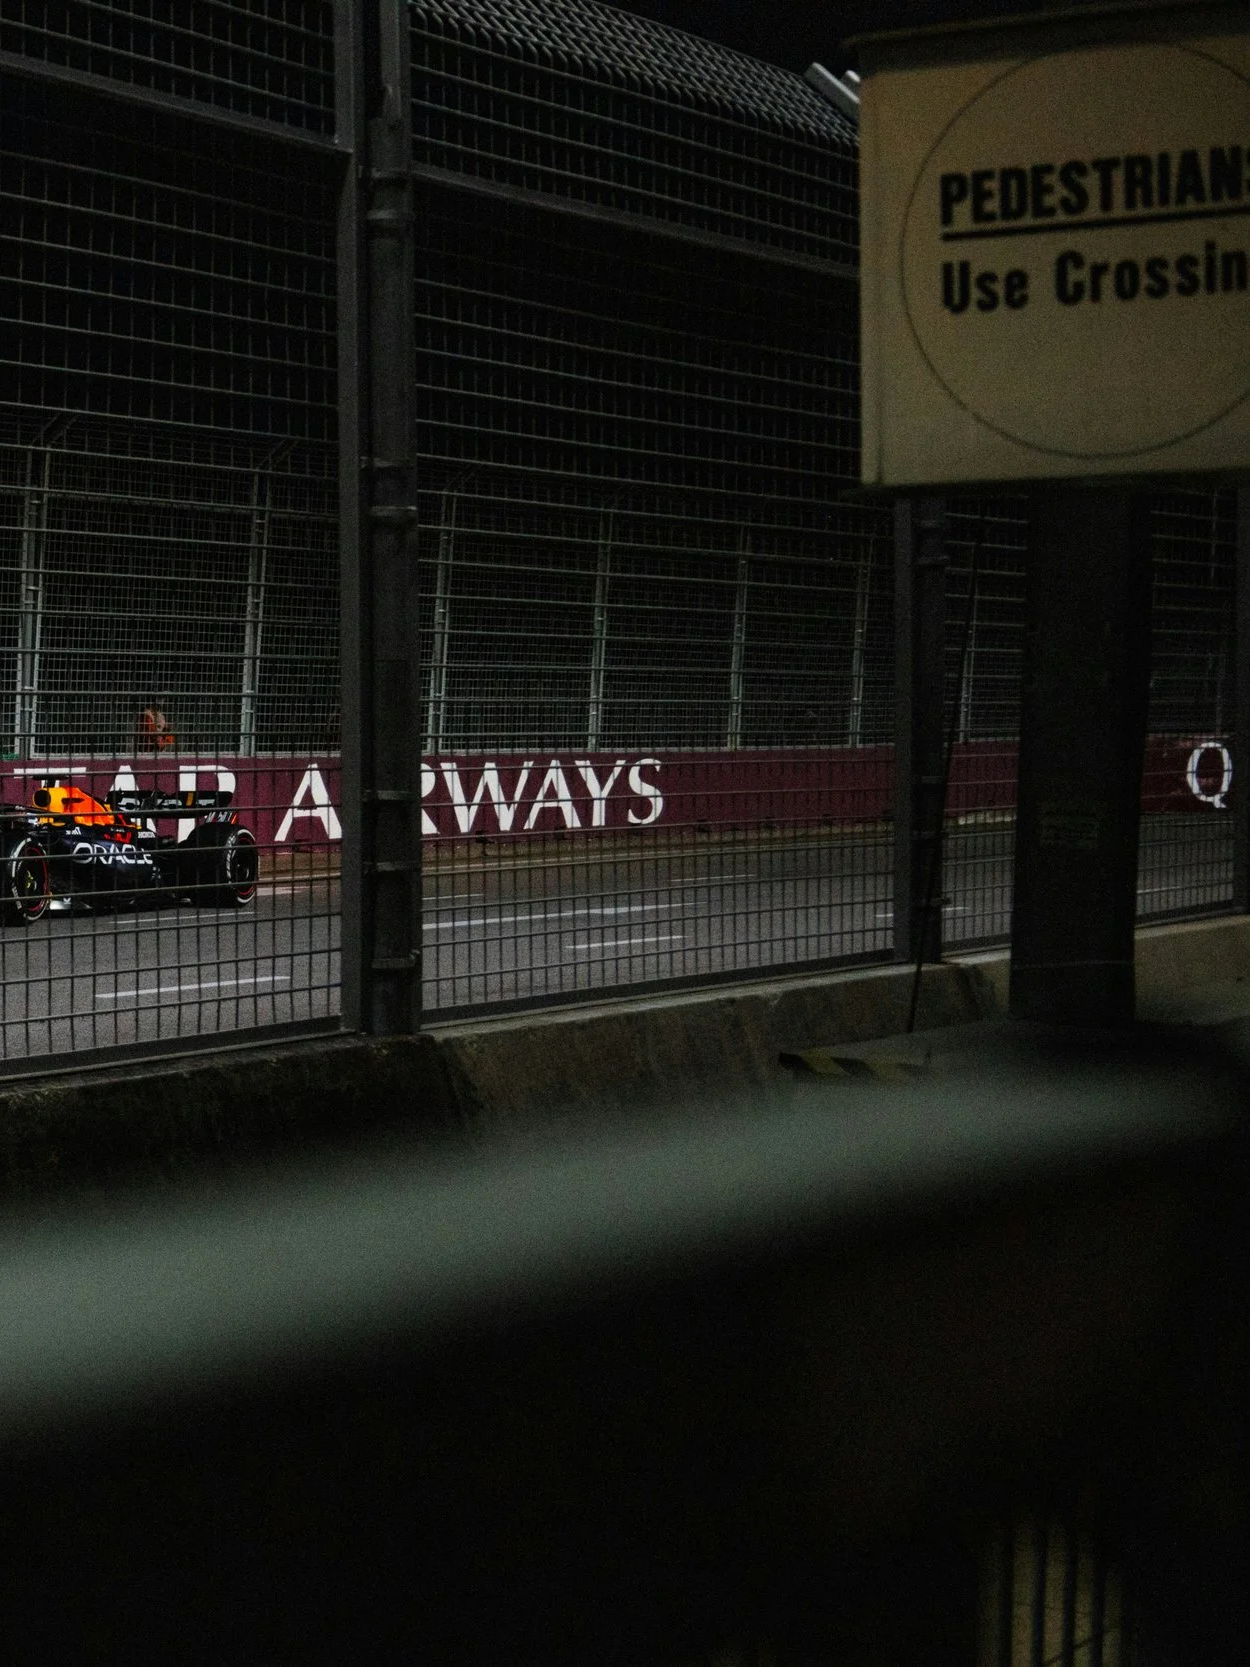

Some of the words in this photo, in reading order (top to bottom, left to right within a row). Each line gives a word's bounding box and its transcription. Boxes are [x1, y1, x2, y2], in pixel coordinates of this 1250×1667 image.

[942, 260, 1028, 313] Use
[1055, 240, 1248, 304] Crossin
[273, 757, 664, 842] AWAYS
